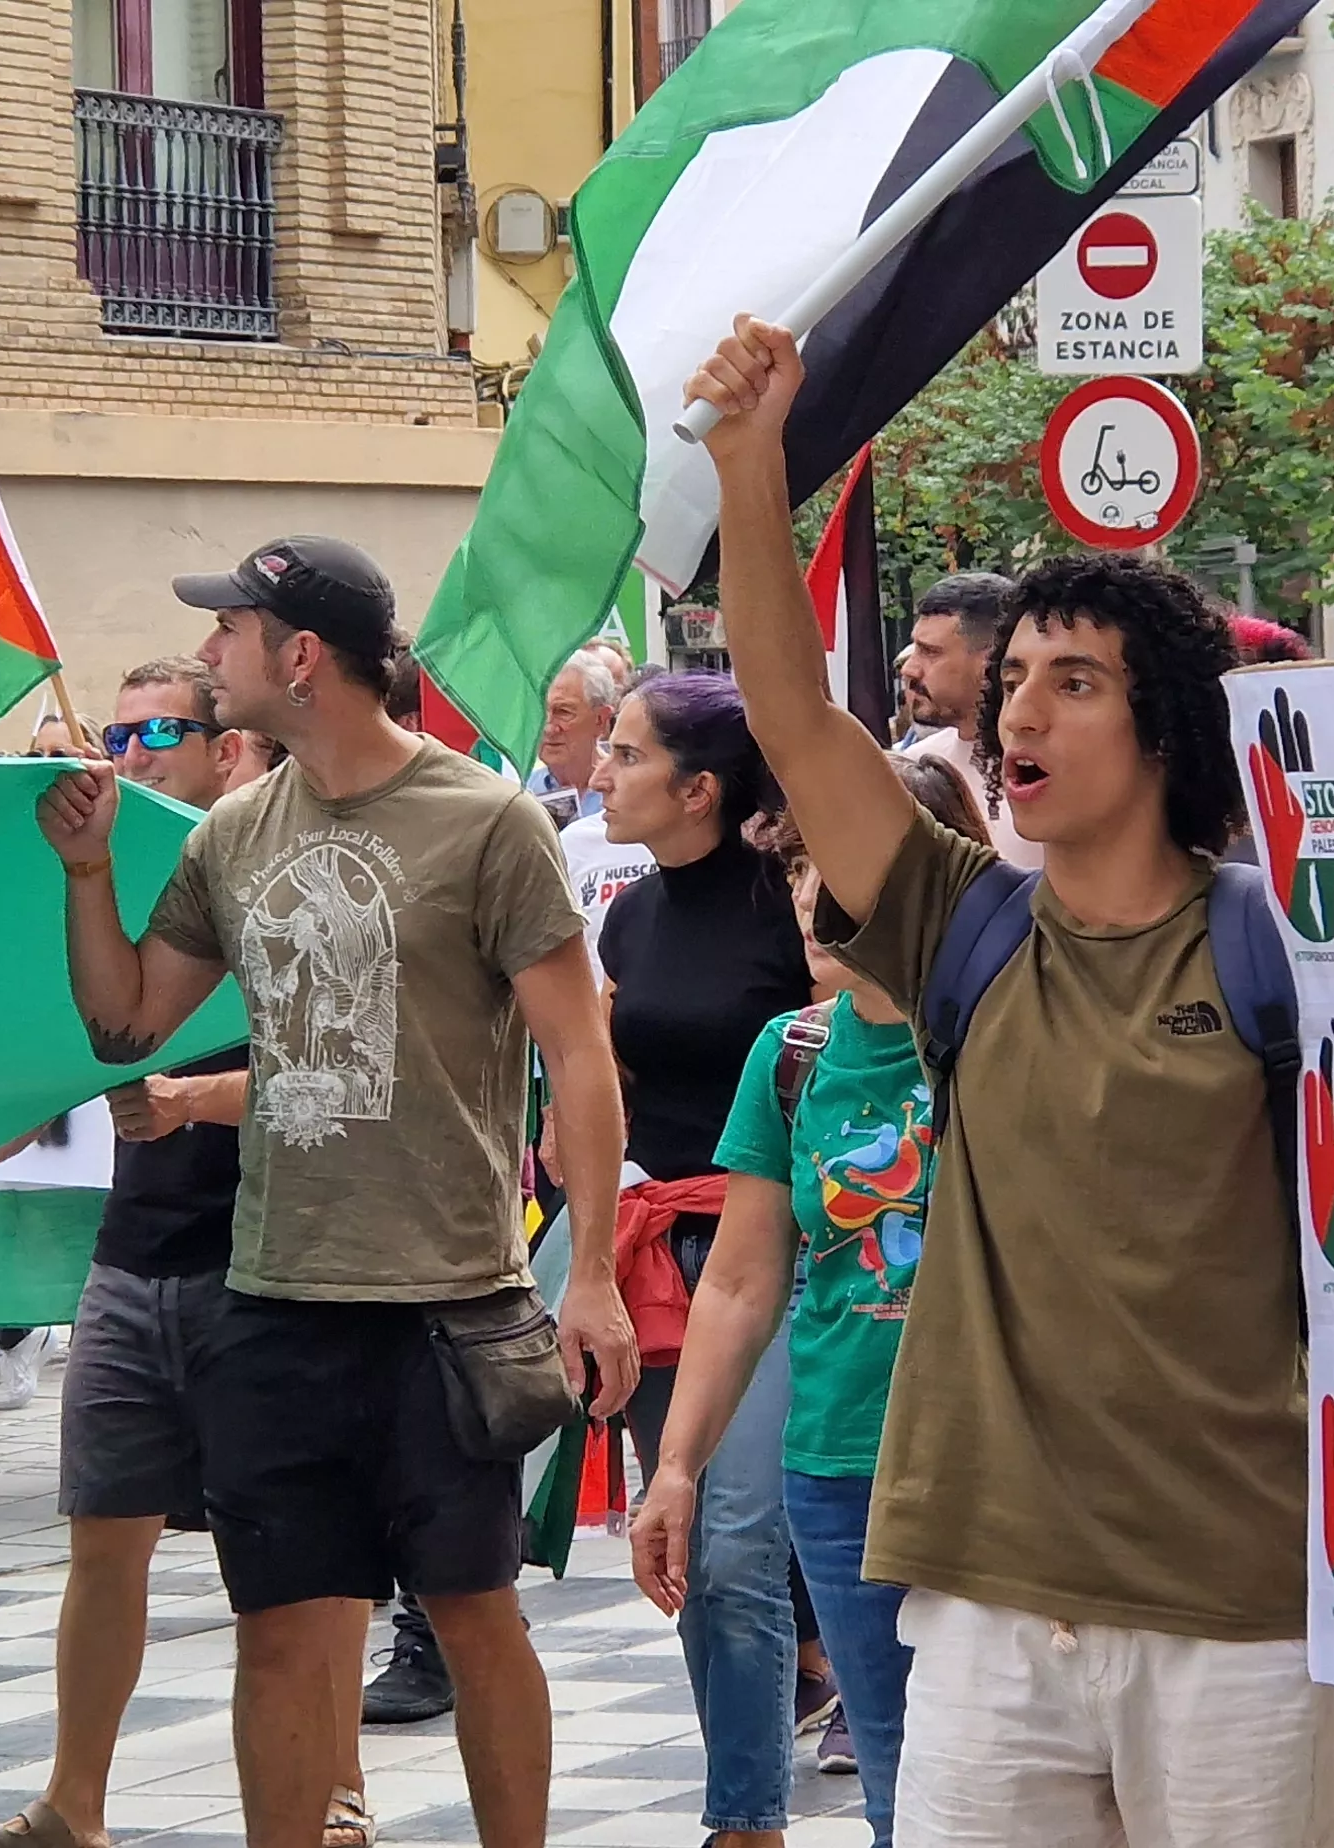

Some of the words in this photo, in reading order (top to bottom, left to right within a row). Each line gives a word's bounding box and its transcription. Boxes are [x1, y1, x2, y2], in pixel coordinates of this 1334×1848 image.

[1144, 159, 1188, 169] ANCIA
[1061, 312, 1128, 330] ZONA
[1144, 311, 1174, 329] DE
[1056, 341, 1180, 360] ESTANCIA
[296, 830, 325, 848] Your
[327, 825, 369, 846] Local
[365, 834, 406, 885] Folklore
[604, 863, 658, 881] HUESCA
